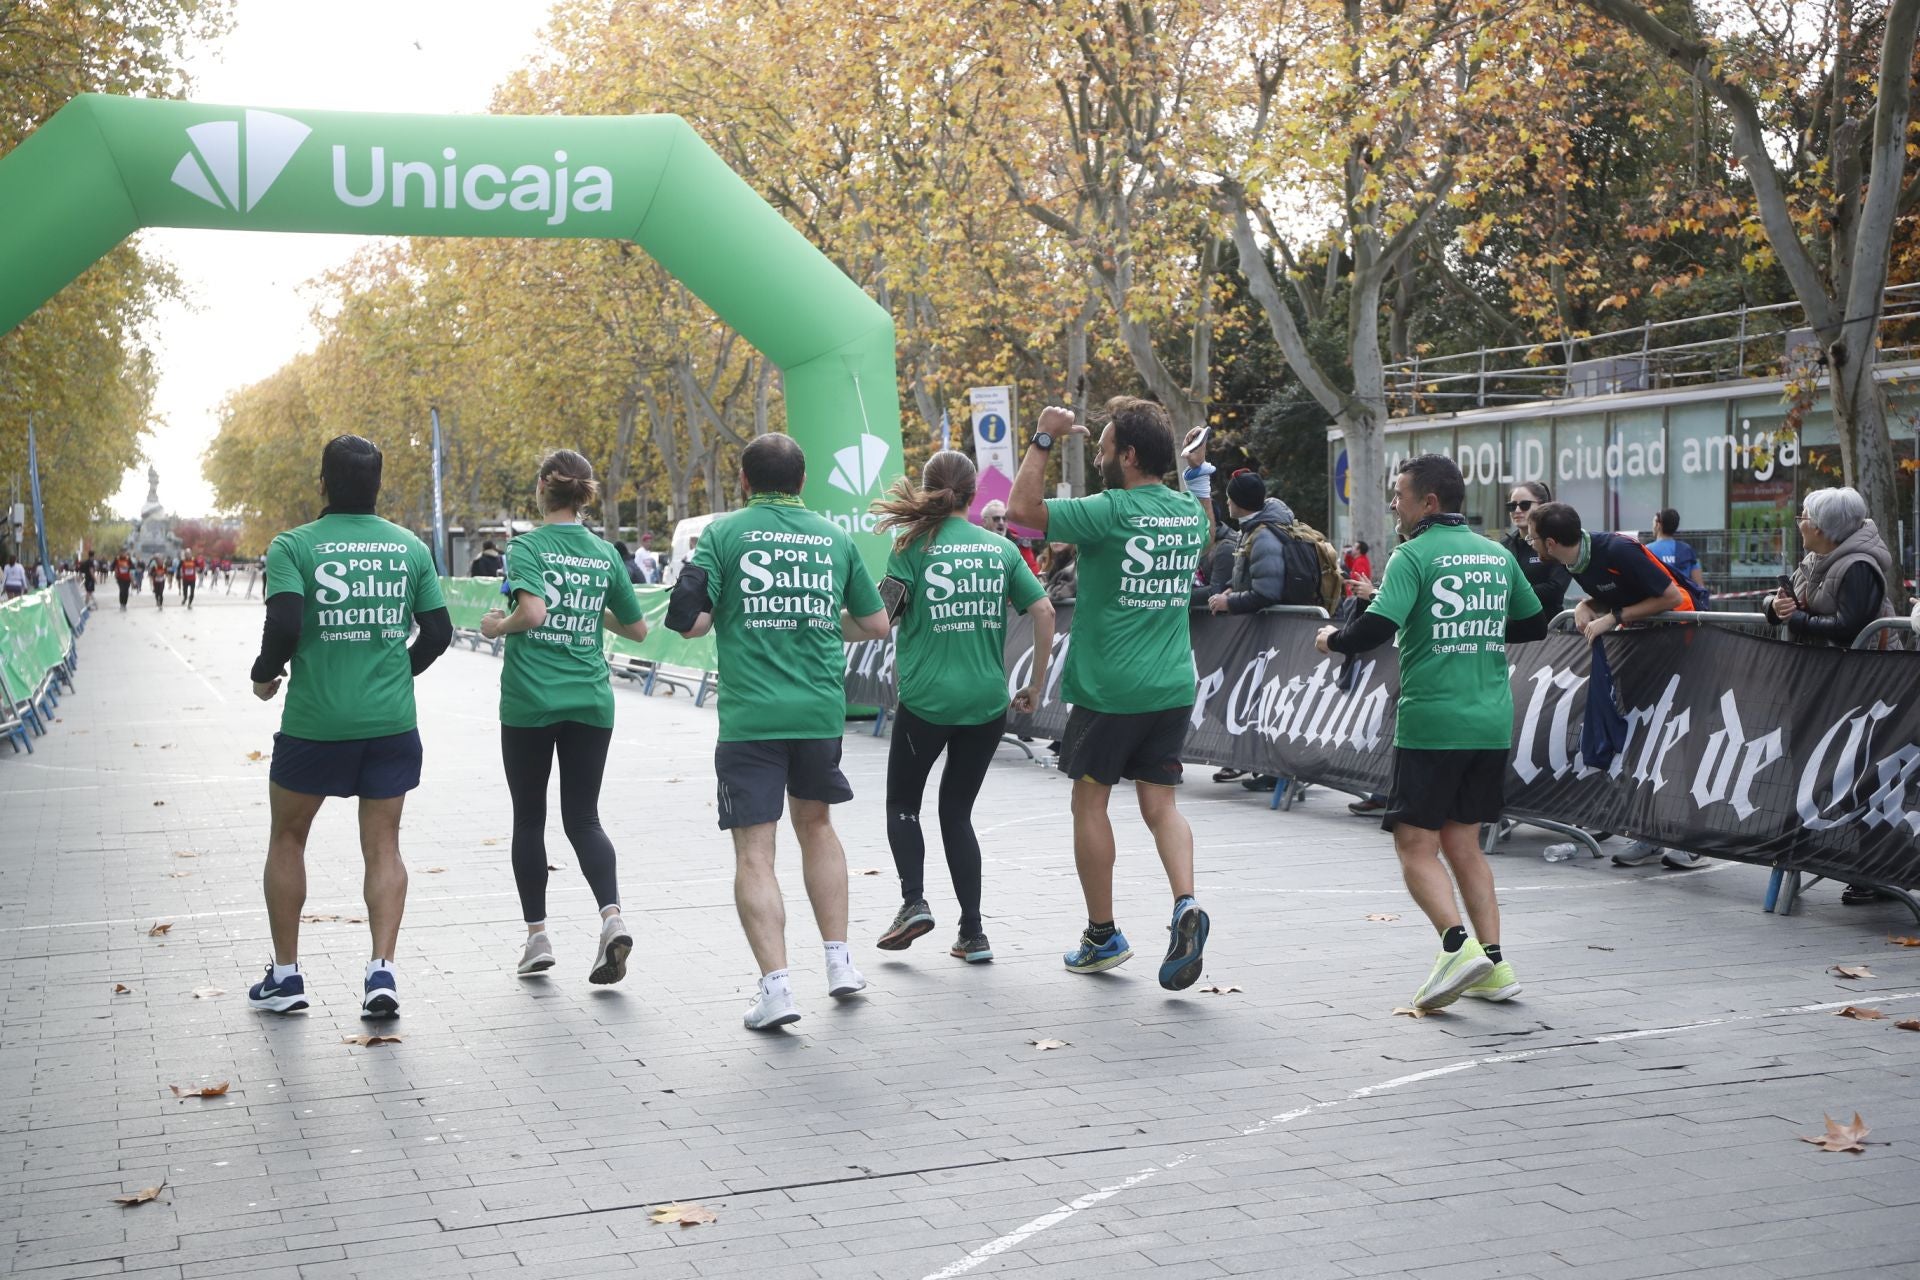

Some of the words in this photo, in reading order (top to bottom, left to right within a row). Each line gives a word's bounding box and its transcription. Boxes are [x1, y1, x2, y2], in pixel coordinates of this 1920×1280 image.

[332, 145, 613, 225] Unicaja
[1558, 427, 1665, 481] ciudad
[1682, 419, 1801, 481] amiga
[1136, 515, 1199, 528] CORRIENDO
[745, 530, 833, 546] CORRIENDO
[1157, 534, 1183, 546] POR
[1188, 533, 1202, 545] LA
[319, 542, 408, 553] CORRIENDO
[932, 544, 1002, 555] CORRIENDO
[1121, 535, 1201, 576] Salud
[545, 553, 611, 570] CORRIENDO
[774, 549, 808, 562] POR
[815, 552, 833, 565] LA
[954, 559, 984, 569] POR
[989, 558, 1005, 570] LA
[1437, 555, 1507, 567] CORRIENDO
[349, 559, 382, 571] POR
[389, 559, 408, 572] LA
[740, 550, 833, 594] Salud
[315, 561, 407, 605] Salud
[565, 572, 591, 585] POR
[595, 576, 608, 587] LA
[925, 562, 1004, 601] Salud
[1120, 571, 1196, 594] mental
[1464, 571, 1491, 583] POR
[1495, 572, 1507, 585] LA
[542, 570, 606, 611] Salud
[1431, 575, 1507, 618] Salud
[742, 592, 834, 618] mental
[928, 596, 1003, 620] mental
[1128, 598, 1166, 608] ensuma
[317, 602, 406, 626] mental
[752, 619, 798, 628] ensuma
[808, 618, 835, 630] intras
[941, 622, 975, 632] ensuma
[1432, 615, 1505, 639] mental
[330, 631, 371, 641] ensuma
[534, 632, 573, 642] ensuma
[1690, 688, 1783, 821] de
